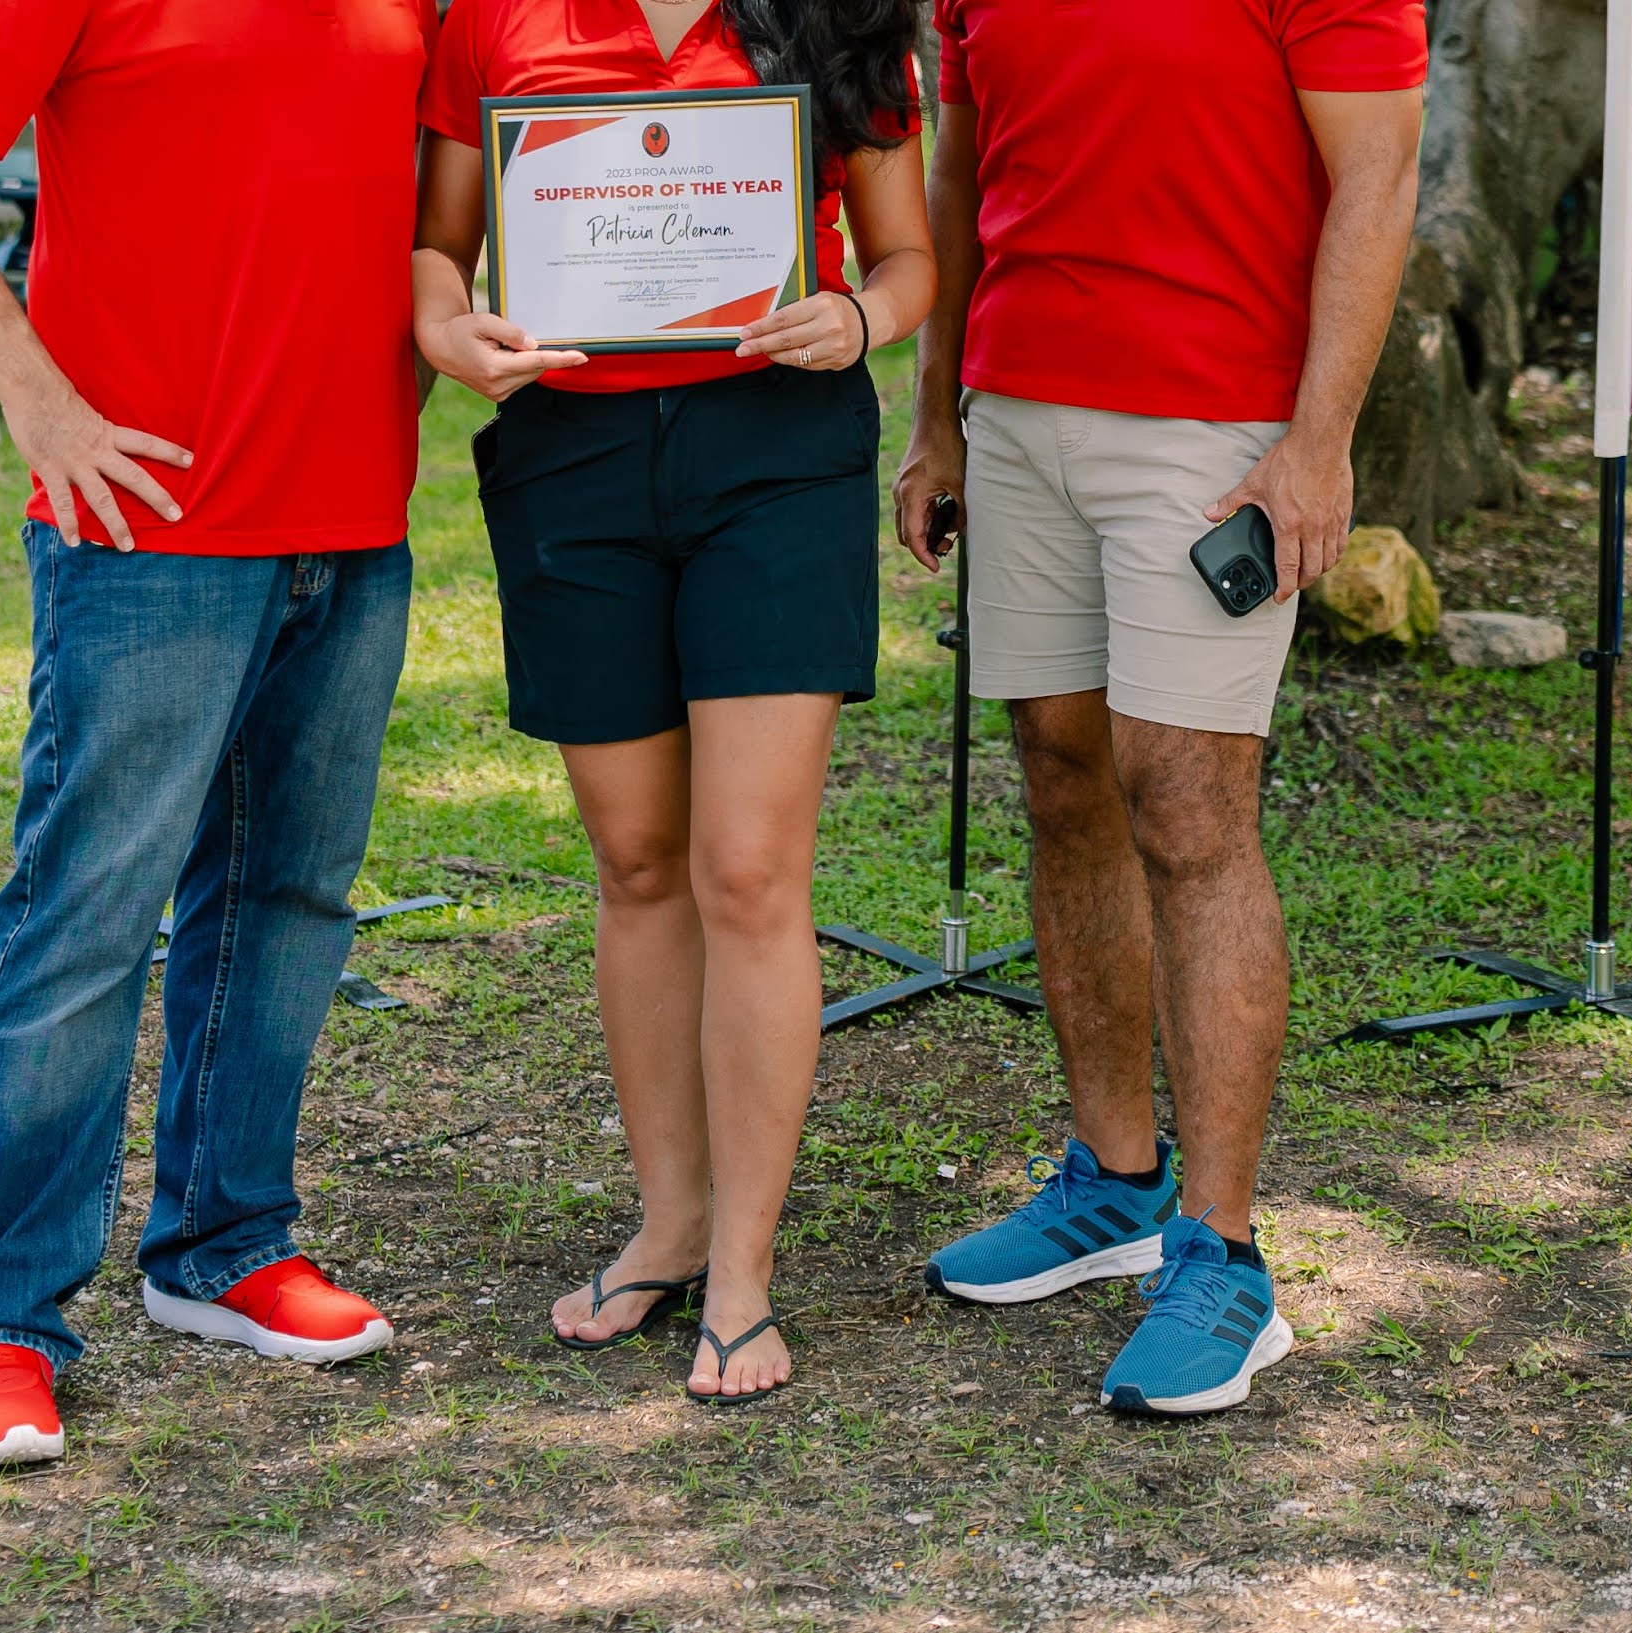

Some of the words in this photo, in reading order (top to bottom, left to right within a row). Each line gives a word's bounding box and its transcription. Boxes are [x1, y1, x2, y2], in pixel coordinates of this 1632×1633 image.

[605, 168, 632, 179] 2023
[634, 166, 668, 178] PROA
[669, 165, 714, 176] AWARD
[534, 183, 655, 202] SUPERVISOR
[659, 183, 686, 197] OF
[690, 181, 727, 196] THE
[732, 179, 783, 194] YEAR
[628, 204, 636, 212] is
[637, 202, 679, 214] presented
[680, 202, 690, 210] to
[586, 214, 654, 247] Patricia
[661, 213, 734, 246] Coleman
